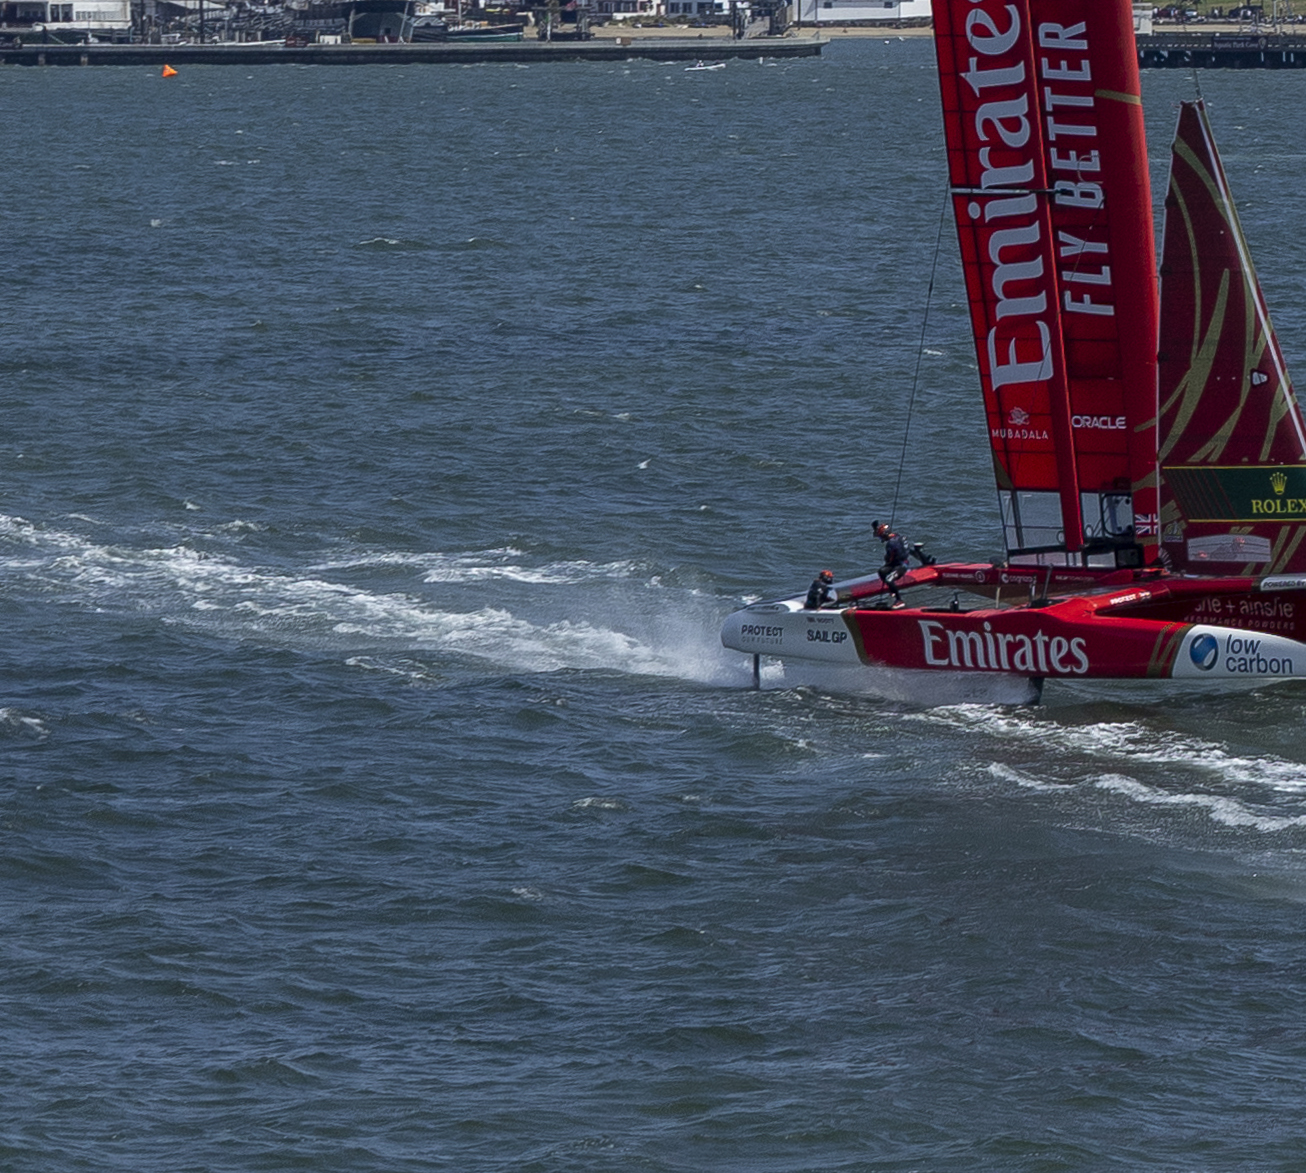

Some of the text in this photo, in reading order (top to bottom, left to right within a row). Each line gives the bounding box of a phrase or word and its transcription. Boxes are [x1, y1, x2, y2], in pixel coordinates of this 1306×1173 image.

[1039, 21, 1114, 316] FLY BETTER
[1071, 415, 1127, 430] ORACLE
[991, 428, 1049, 440] MUBADALA
[741, 624, 784, 637] PROTECT
[918, 620, 1089, 675] Emirates
[1225, 634, 1261, 655] low
[1225, 653, 1293, 674] carbon
